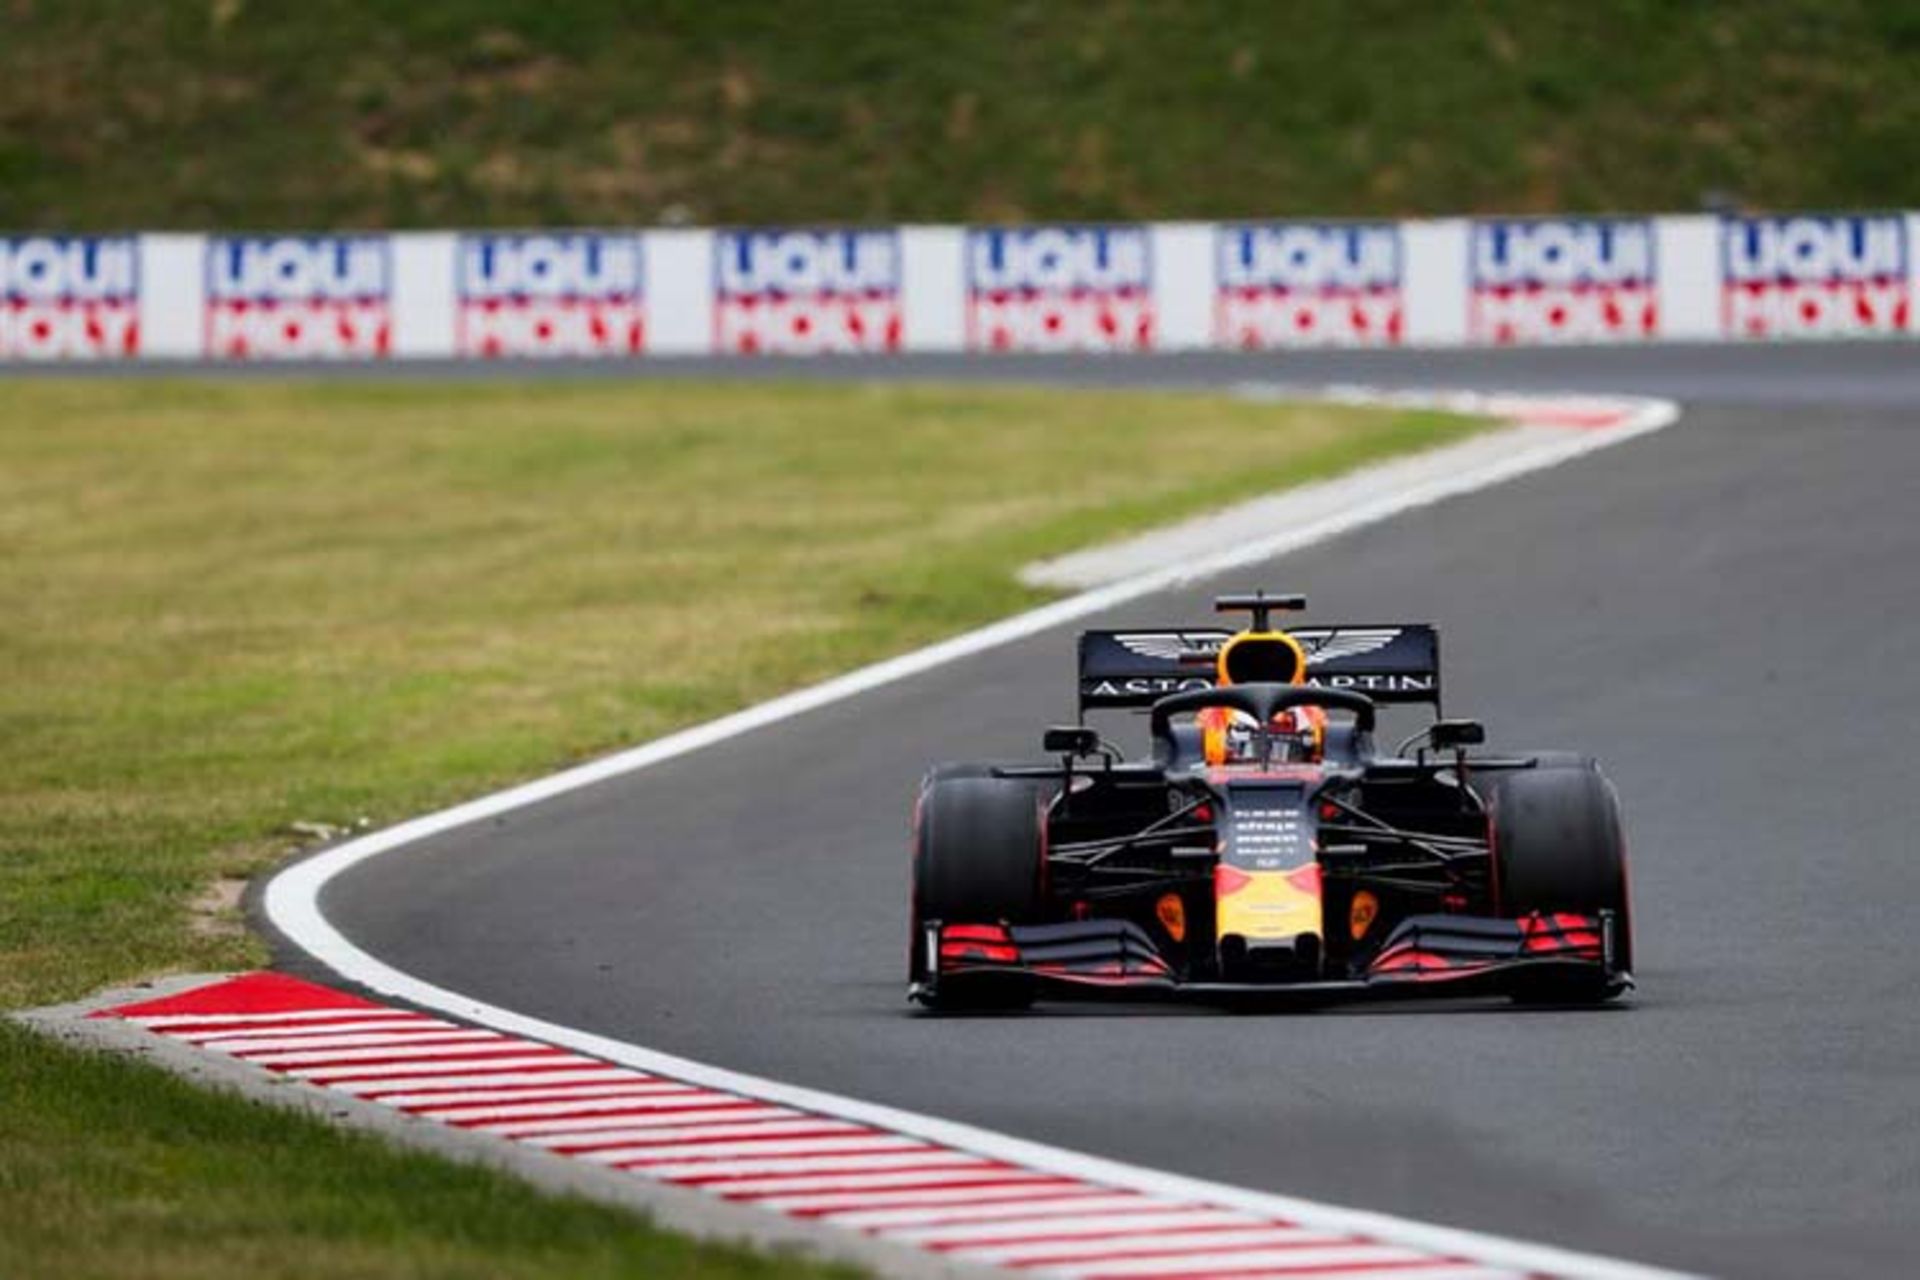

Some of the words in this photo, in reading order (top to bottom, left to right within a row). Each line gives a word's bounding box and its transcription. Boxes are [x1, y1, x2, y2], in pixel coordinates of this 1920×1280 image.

[208, 236, 392, 299] LIQUI
[459, 235, 642, 298] LIQUI
[718, 231, 898, 296] LIQUI
[971, 229, 1150, 293] LIQUI
[1220, 227, 1400, 289] LIQUI
[1473, 224, 1655, 286] LIQUI
[1723, 218, 1905, 281] LIQUI
[208, 300, 393, 356] MOLY
[459, 299, 643, 356] MOLY
[718, 297, 899, 352] MOLY
[971, 294, 1151, 351] MOLY
[1220, 290, 1401, 346] MOLY
[1473, 287, 1656, 341] MOLY
[1723, 282, 1906, 337] MOLY
[1092, 678, 1213, 695] ASTO
[1305, 674, 1433, 690] ARTIN
